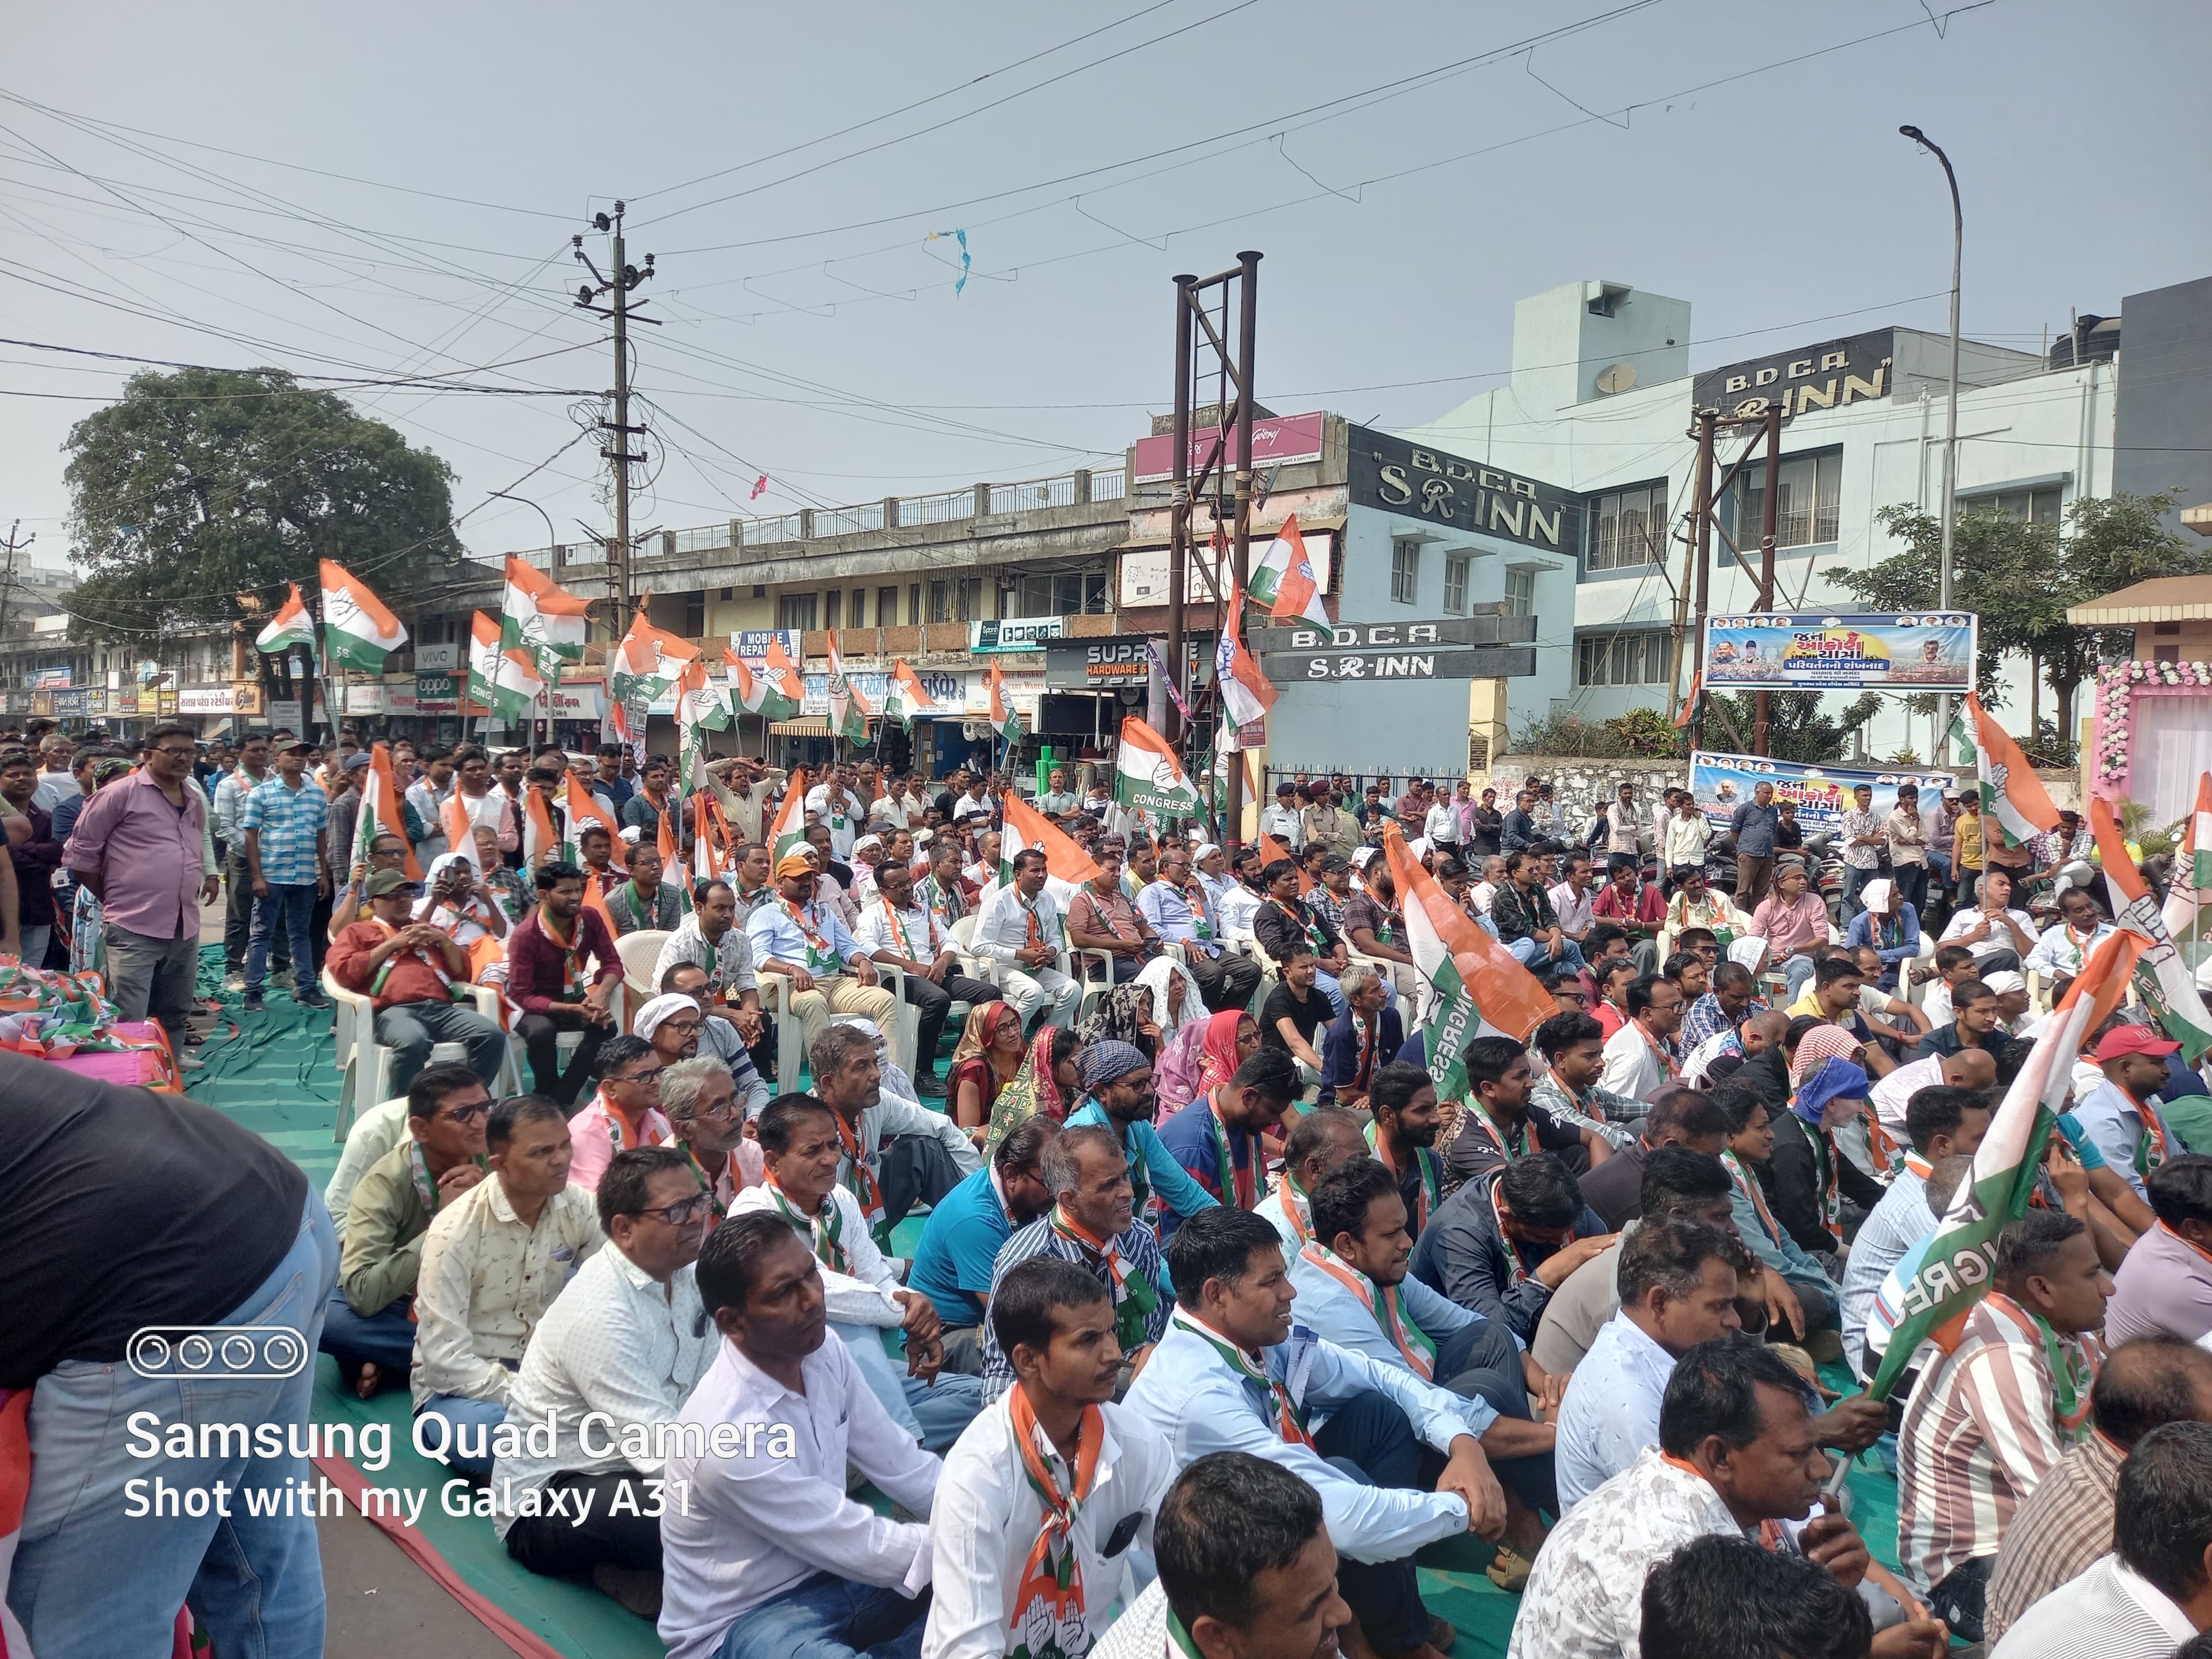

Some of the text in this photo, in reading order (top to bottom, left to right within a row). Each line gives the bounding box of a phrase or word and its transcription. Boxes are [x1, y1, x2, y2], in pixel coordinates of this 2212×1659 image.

[740, 643, 790, 656] REPAIG
[1087, 641, 1199, 663] SUPRE
[422, 650, 448, 664] vivo
[1086, 664, 1147, 676] HARDWARE &
[1787, 660, 1885, 669] પરિવર્તનનો શંખનાદ
[1017, 671, 1043, 679] KRISHNA
[419, 678, 452, 695] oppo
[1024, 681, 1044, 690] WARES
[391, 695, 416, 706] HARDWAR
[1132, 793, 1195, 811] CONGRESS
